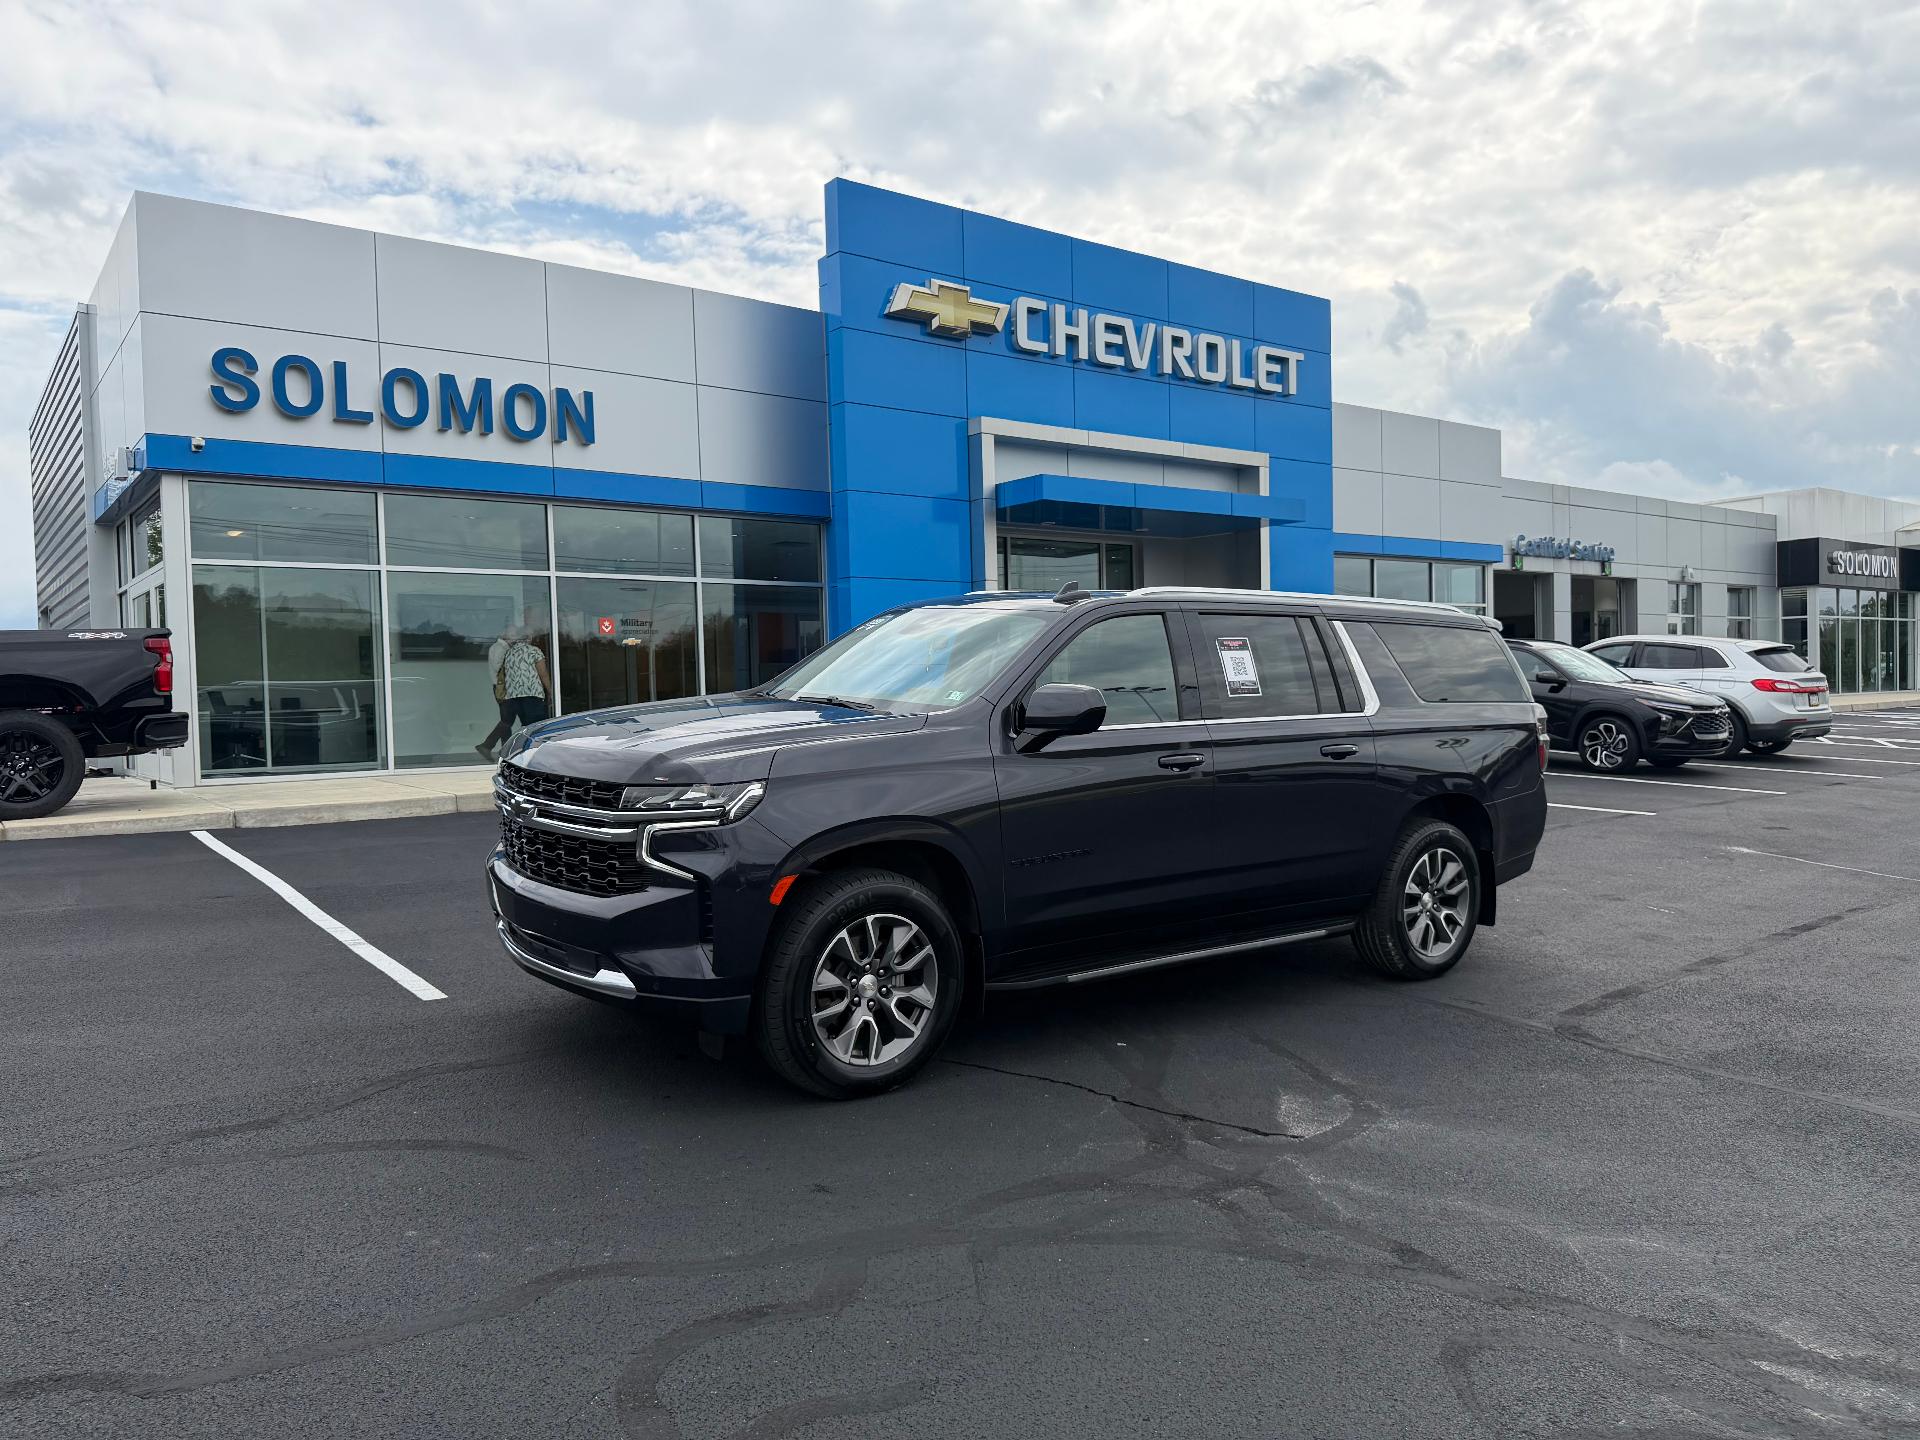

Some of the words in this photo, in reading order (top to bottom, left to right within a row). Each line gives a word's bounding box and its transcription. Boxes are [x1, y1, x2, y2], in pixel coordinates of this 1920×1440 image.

[1011, 296, 1305, 396] CHEVROLET
[209, 347, 596, 446] SOLOMON
[1515, 534, 1570, 558] Certified
[1573, 540, 1615, 562] Service
[1836, 551, 1897, 578] SOLOMON
[620, 618, 653, 629] Military
